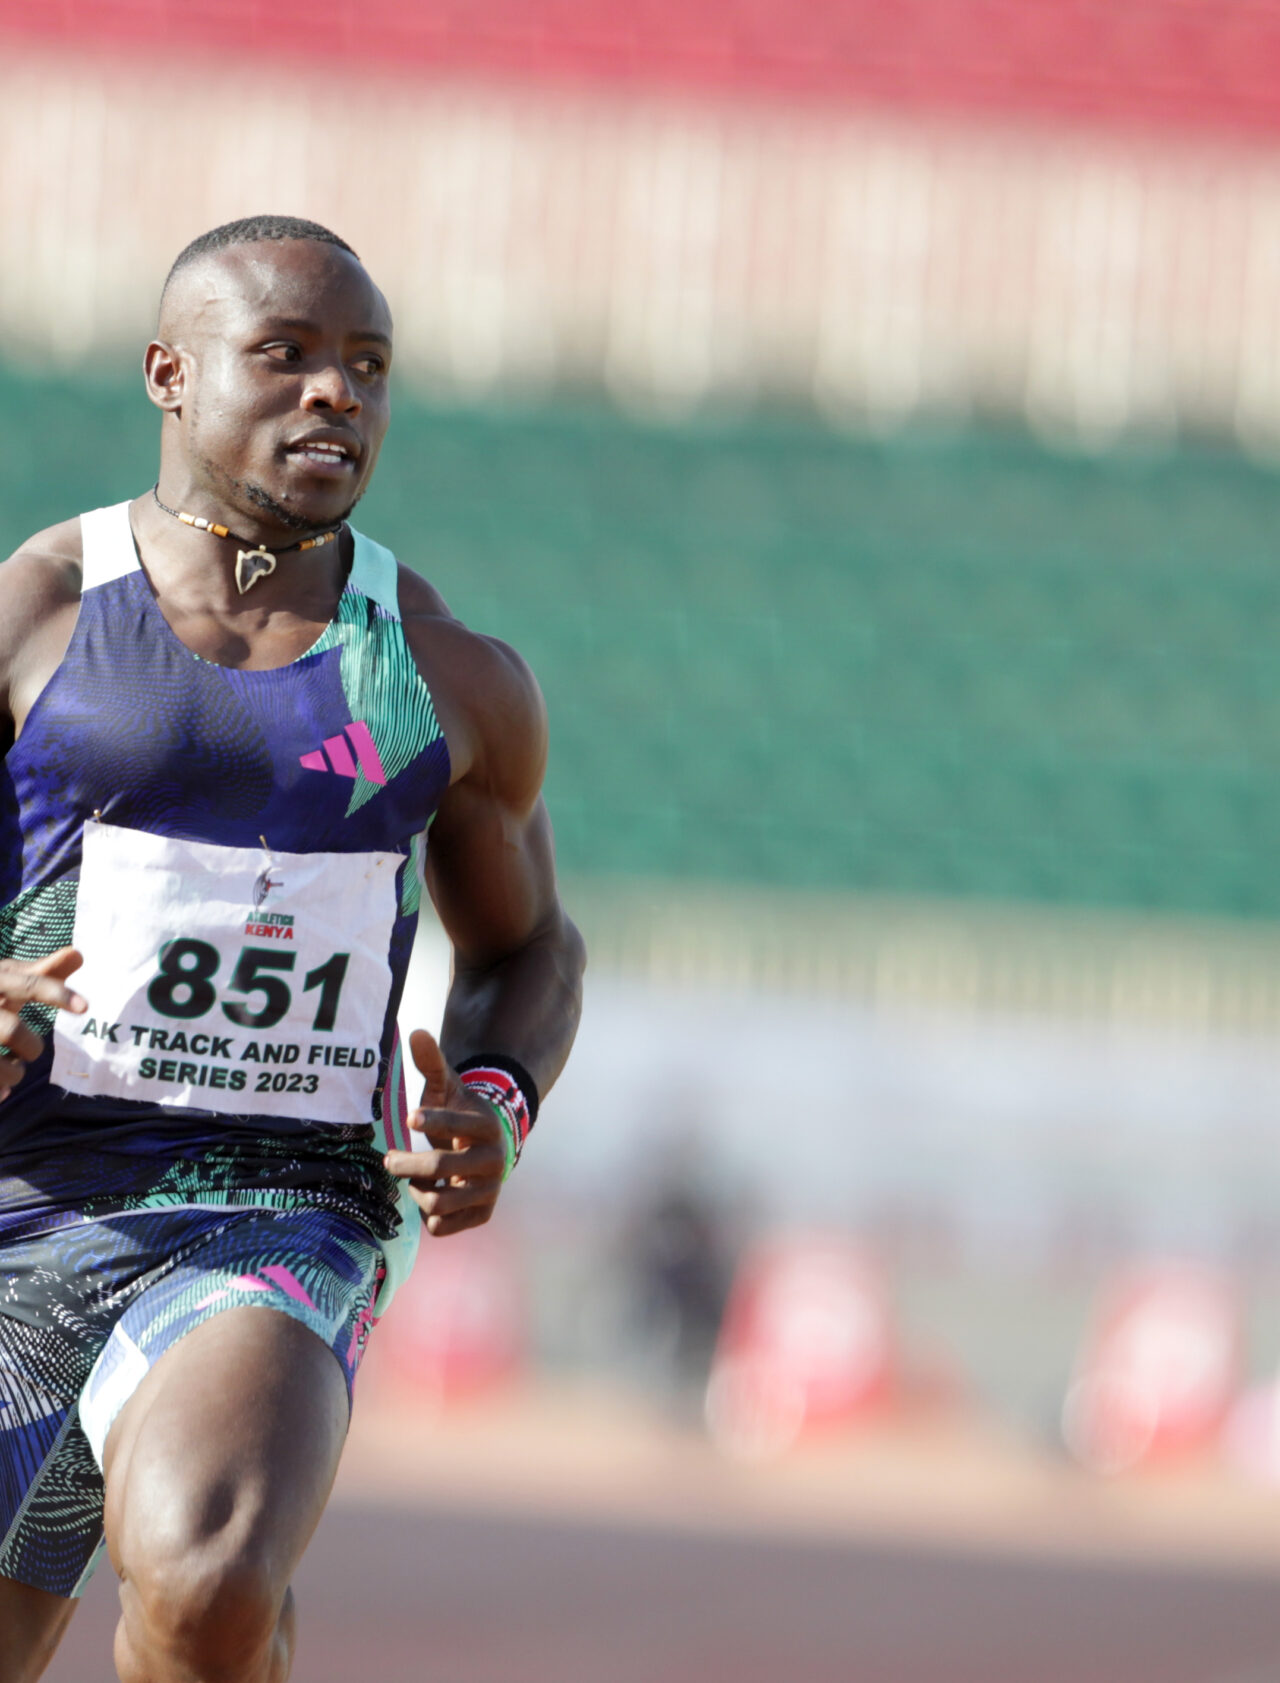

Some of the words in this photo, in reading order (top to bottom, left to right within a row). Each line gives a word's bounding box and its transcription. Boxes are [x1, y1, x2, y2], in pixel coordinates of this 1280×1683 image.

[245, 923, 294, 940] KENYA
[147, 937, 350, 1032] 851
[81, 1017, 122, 1043] AK
[130, 1026, 235, 1059] TRACK
[240, 1042, 300, 1065] AND
[307, 1045, 376, 1069] FIELD
[138, 1058, 247, 1091] SERIES
[254, 1072, 320, 1094] 2023
